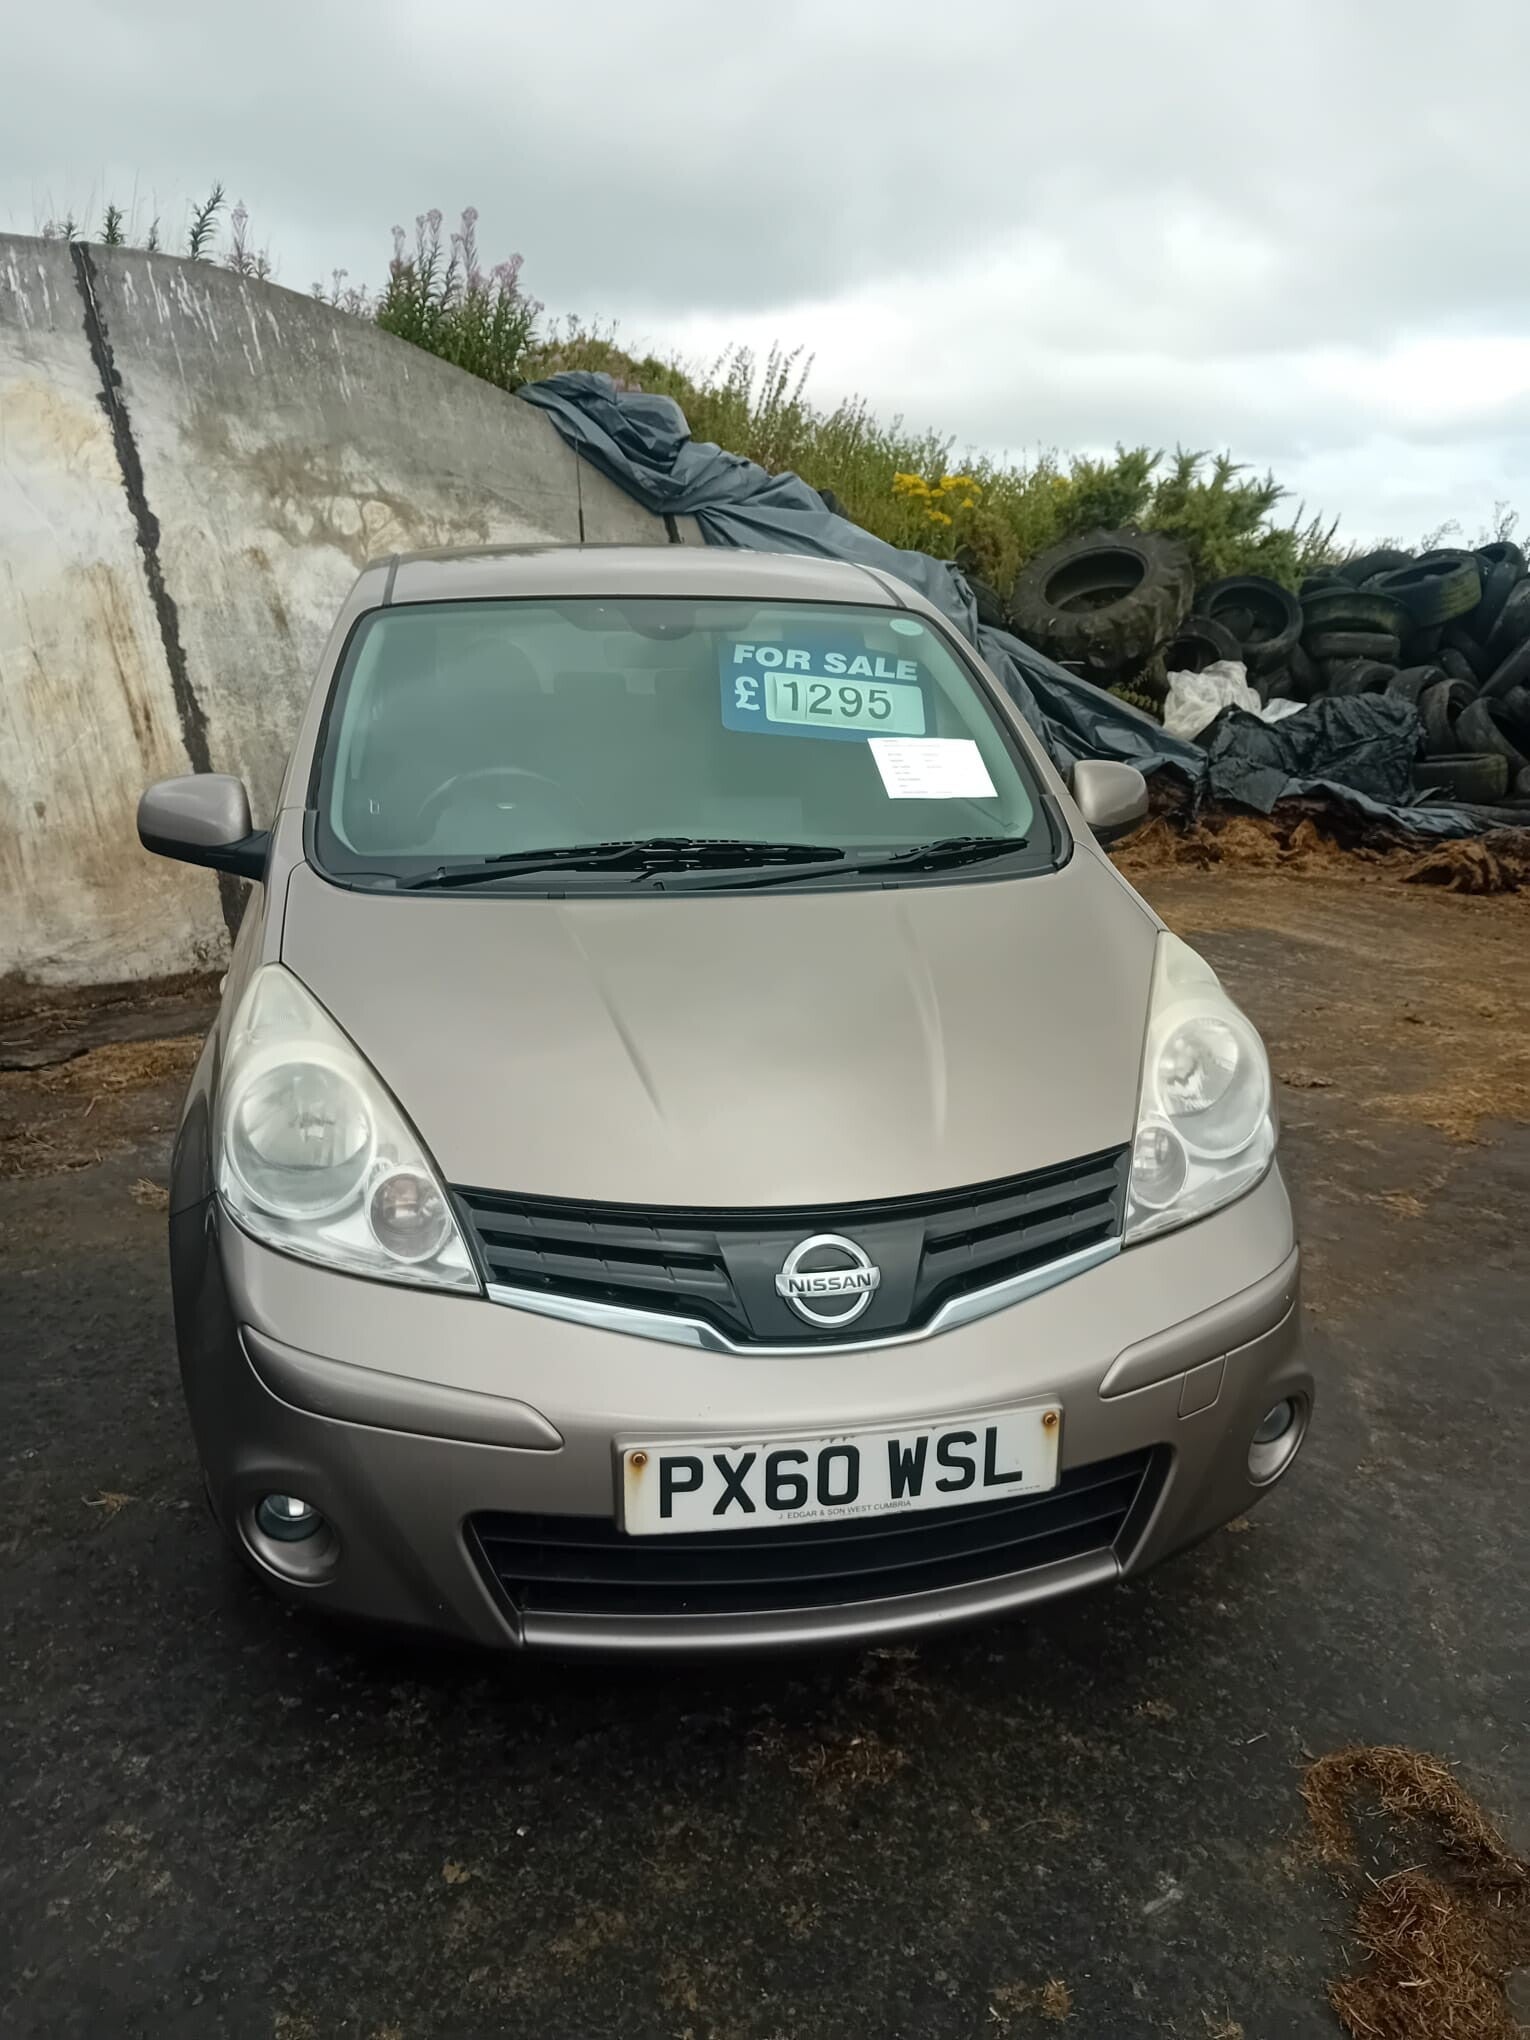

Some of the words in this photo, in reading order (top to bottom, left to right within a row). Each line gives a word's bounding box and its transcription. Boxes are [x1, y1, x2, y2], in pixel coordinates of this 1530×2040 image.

[733, 644, 811, 670] FOR
[823, 652, 918, 681] SALE
[734, 676, 760, 711] £
[782, 681, 892, 720] 1295
[788, 1272, 872, 1293] NISSAN
[659, 1444, 860, 1519] PX60
[887, 1426, 1024, 1499] WSL
[787, 1510, 818, 1519] EDGAR
[828, 1508, 846, 1516] SON
[848, 1505, 872, 1514] WEST
[874, 1500, 912, 1511] CUMBRIA
